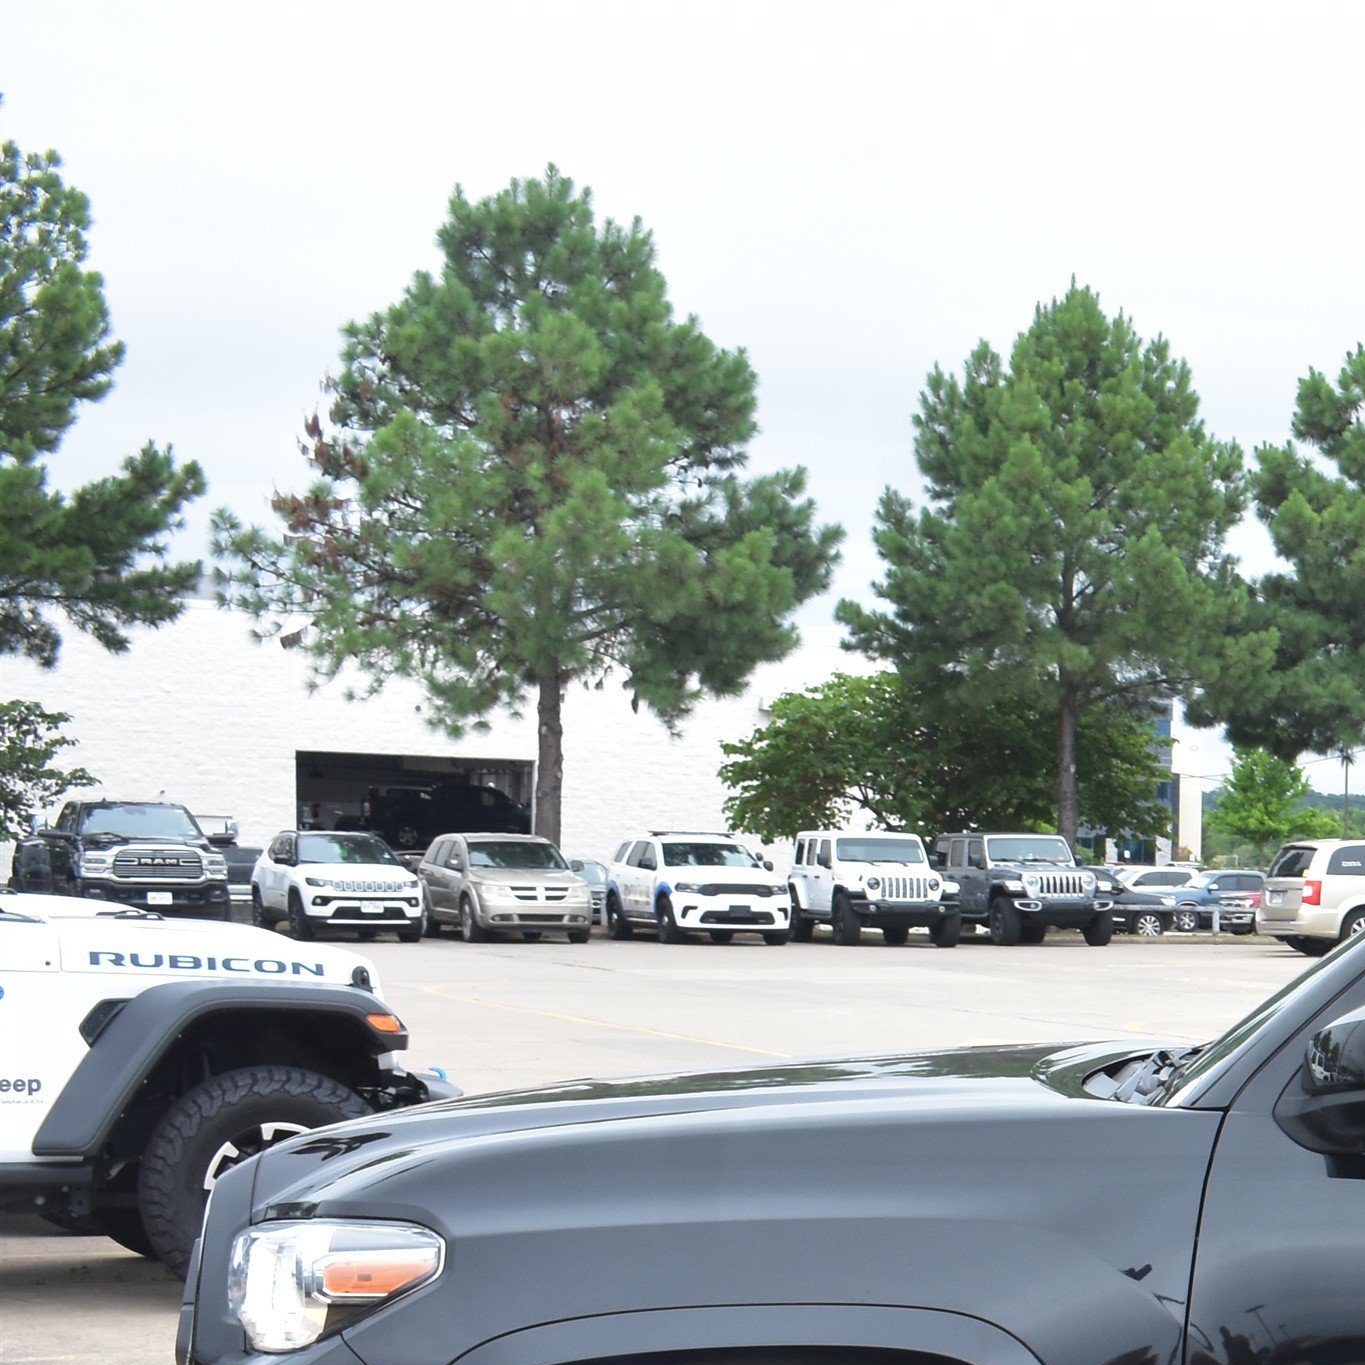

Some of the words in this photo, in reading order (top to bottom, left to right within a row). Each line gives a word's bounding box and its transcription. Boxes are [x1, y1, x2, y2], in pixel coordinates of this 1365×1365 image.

[140, 858, 178, 866] RAM
[89, 950, 325, 977] RUBICON
[0, 1078, 42, 1096] eep
